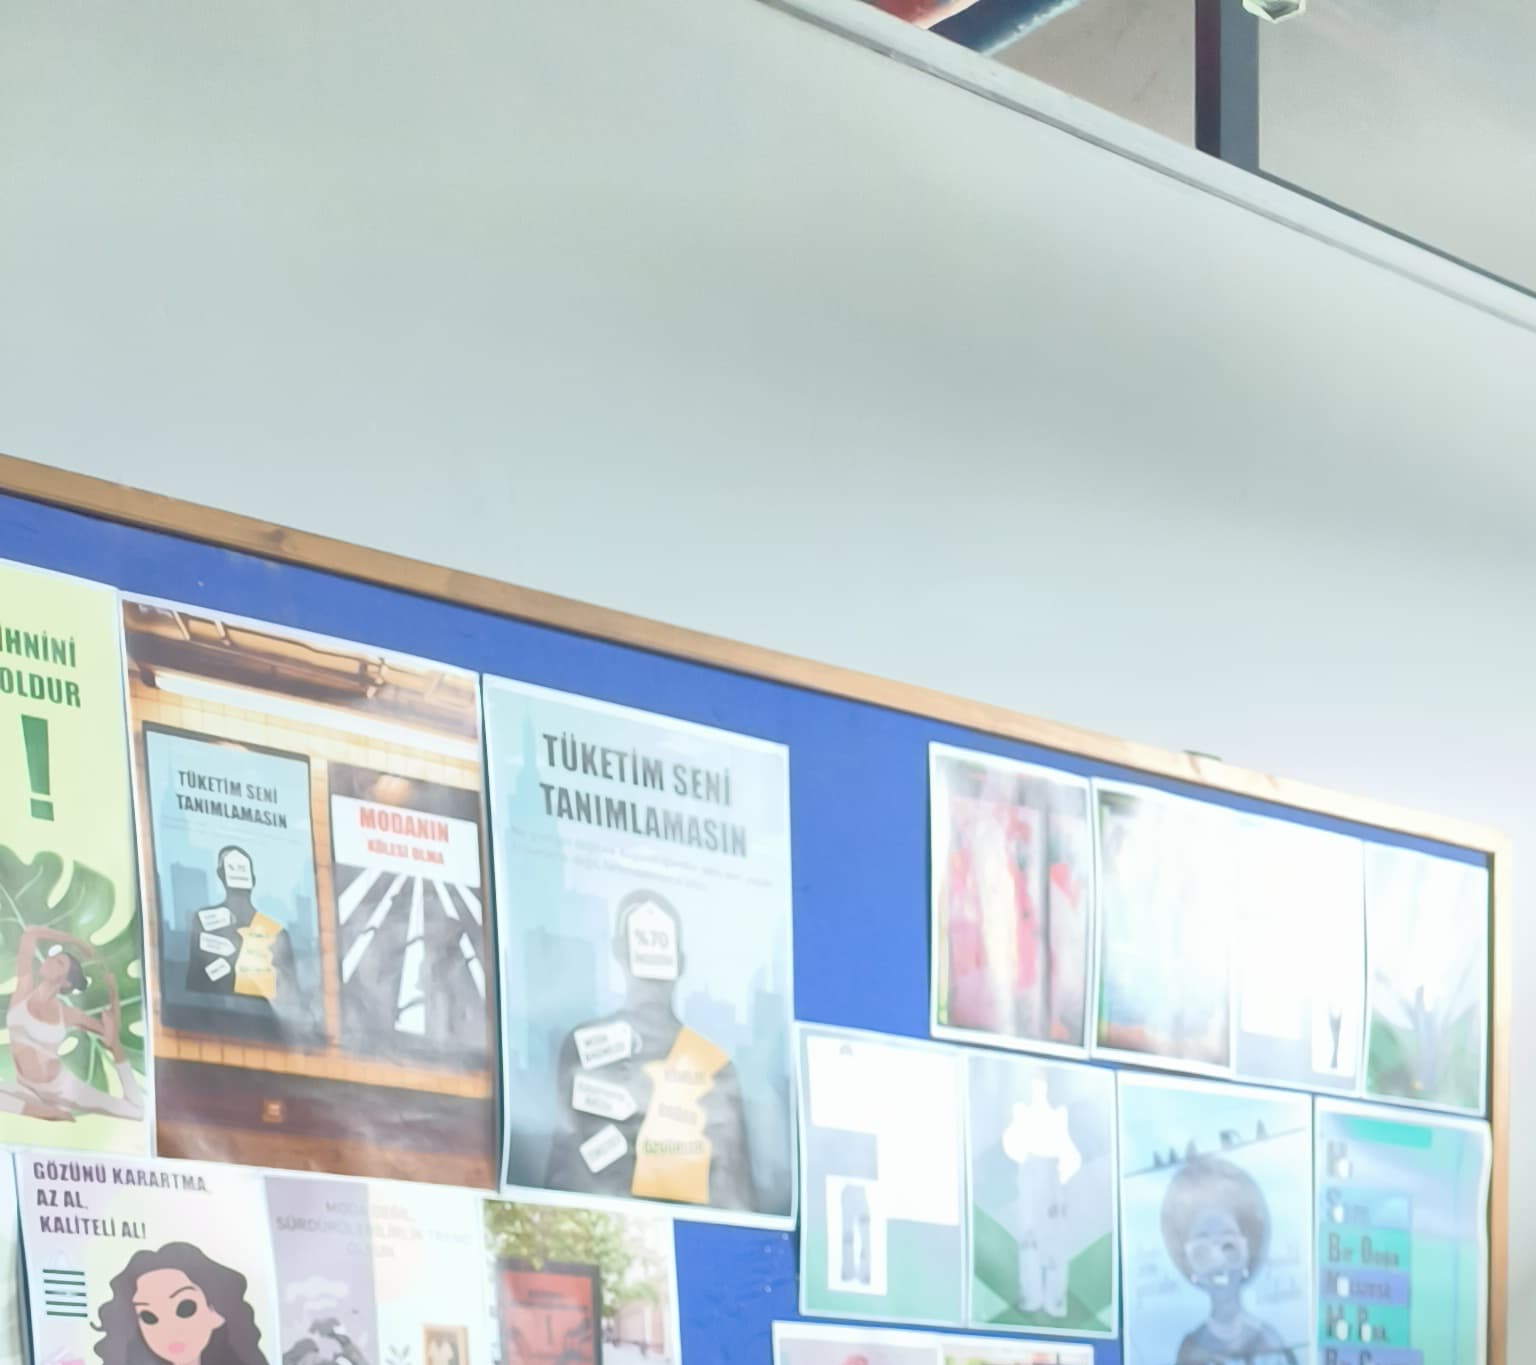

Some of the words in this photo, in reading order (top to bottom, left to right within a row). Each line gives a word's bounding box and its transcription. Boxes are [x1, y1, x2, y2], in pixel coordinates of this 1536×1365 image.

[0, 627, 76, 668] HNİNİ
[542, 731, 665, 792] TÜKETİM
[673, 762, 731, 807] SENİ
[178, 770, 242, 799] TÜKETİM
[246, 783, 278, 805] SENİ
[175, 793, 288, 829] TANIMLAMASIN
[359, 806, 449, 843] MODANIN
[539, 781, 748, 859] TANIMLAMASIN
[33, 1160, 107, 1184] GÖZÜNÜ
[36, 1188, 58, 1207] AZ
[40, 1213, 116, 1237] KALİTELİ
[121, 1221, 146, 1239] AL!
